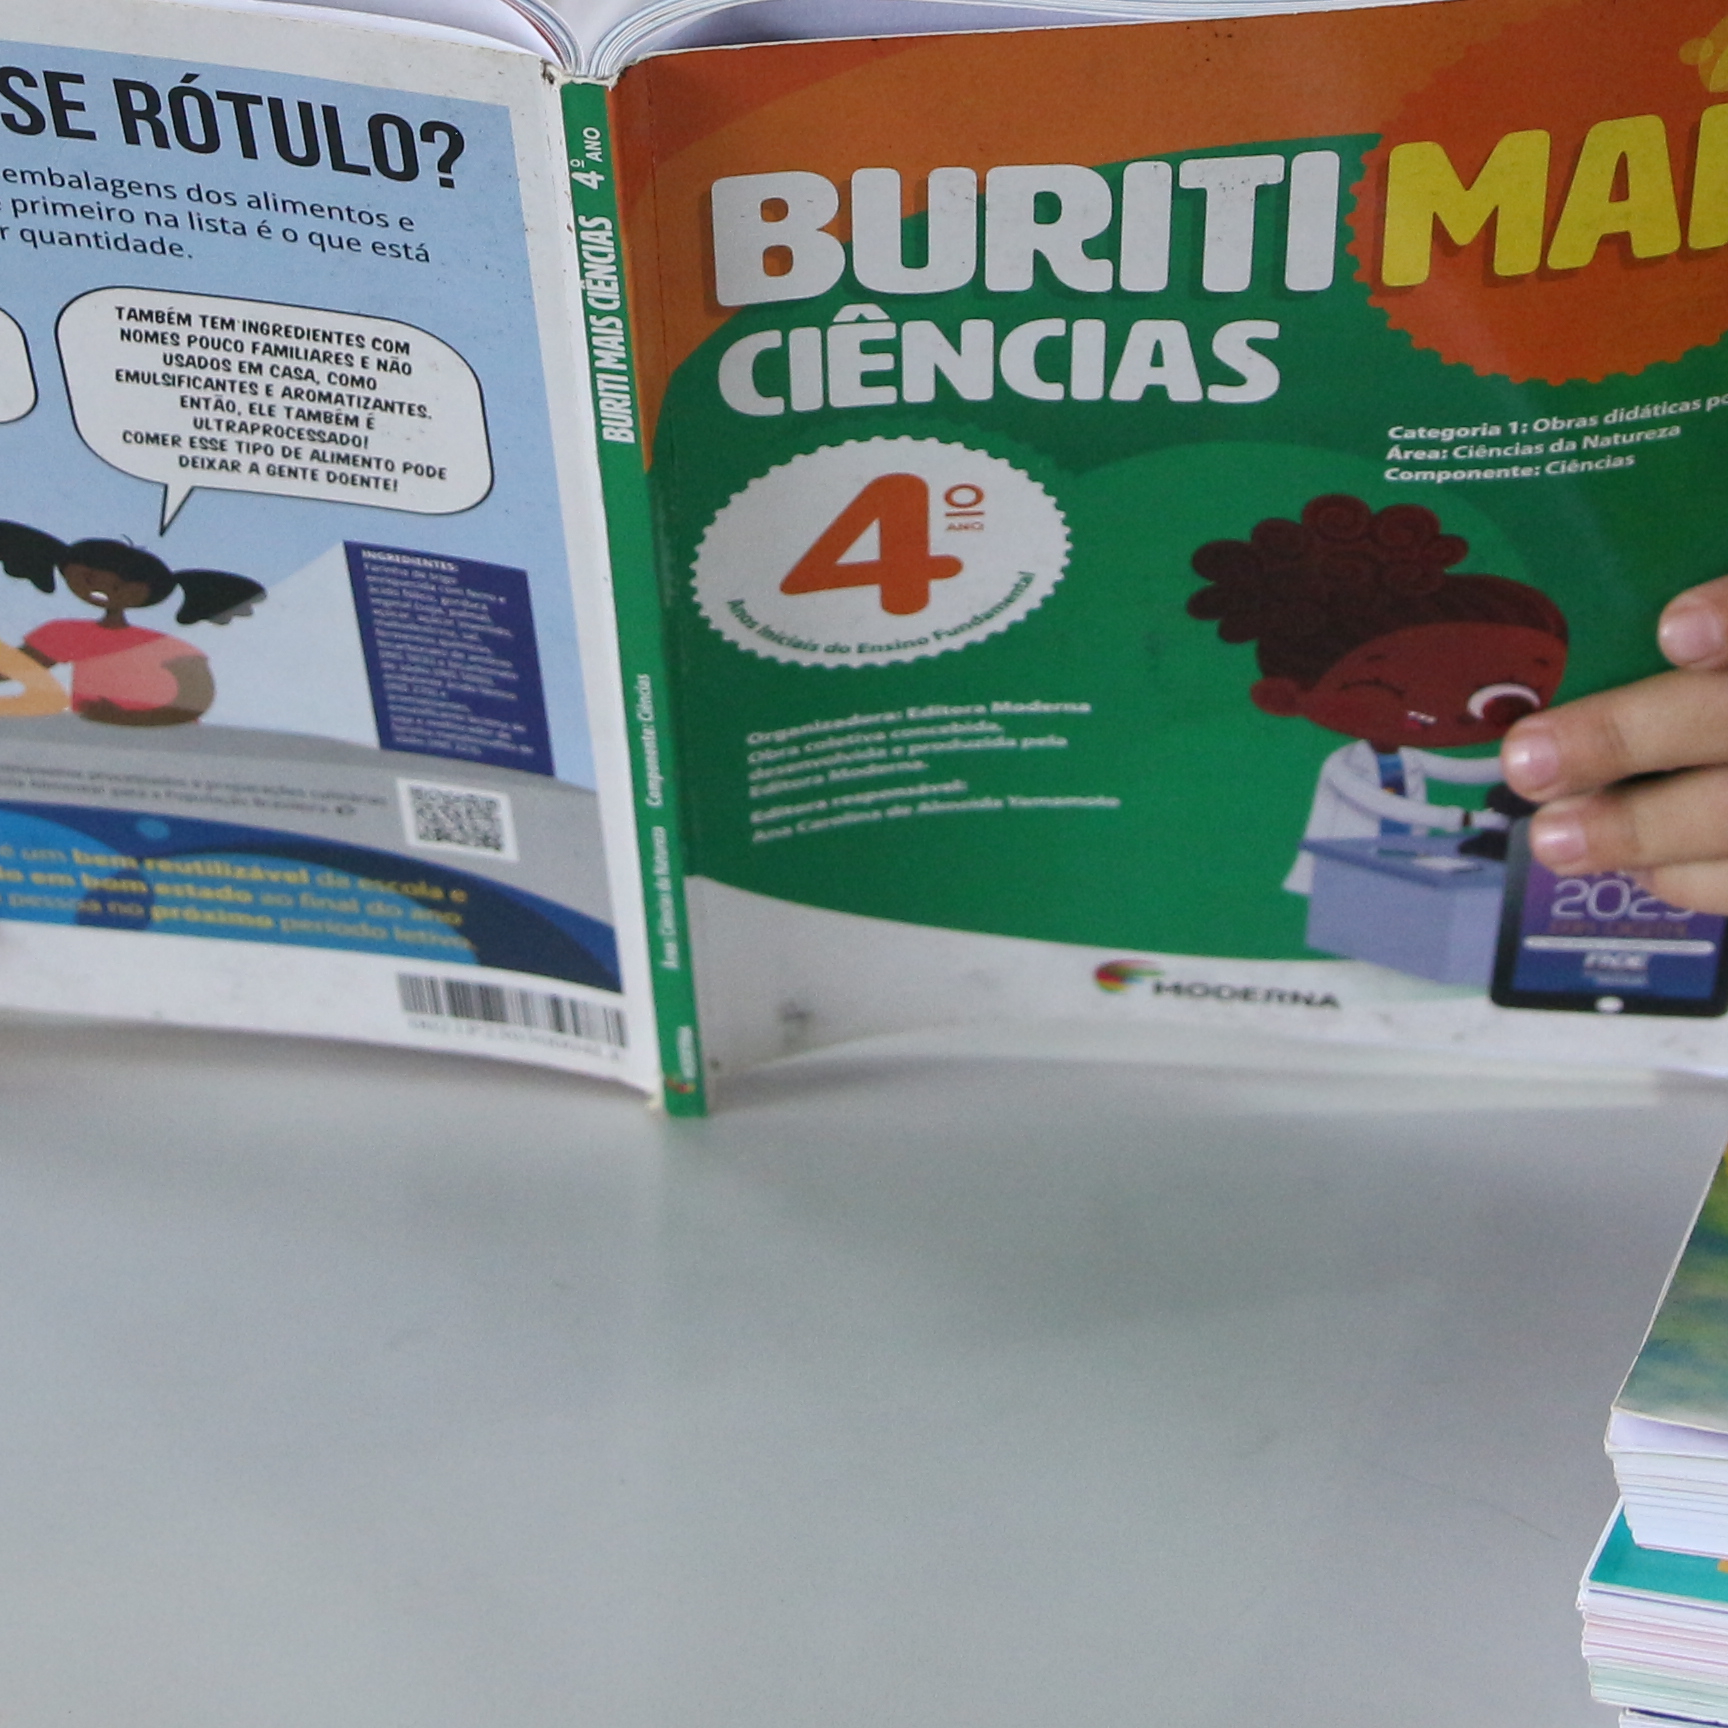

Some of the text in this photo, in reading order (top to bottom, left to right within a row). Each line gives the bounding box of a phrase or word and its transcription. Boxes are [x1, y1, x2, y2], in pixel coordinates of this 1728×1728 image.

[112, 73, 466, 190] RÓTULO?
[582, 126, 605, 164] ANO
[1, 165, 178, 201] embalagens
[185, 182, 238, 207] dos
[246, 190, 390, 229] alimentos
[398, 216, 415, 233] e
[10, 195, 136, 224] primeiro
[143, 210, 180, 230] na
[187, 210, 248, 237] lista
[256, 219, 273, 240] é
[281, 227, 299, 244] o
[307, 231, 362, 254] que
[370, 240, 431, 264] está
[19, 227, 193, 259] quantidade.
[711, 150, 1341, 308] BURITI
[577, 215, 622, 312] CIÊNCIAS
[114, 305, 411, 357] TAMBÉM TEM INGREDIENTES COM
[119, 327, 413, 377] NOMES POUCO FAMILIARES E NÃO
[589, 316, 628, 371] MAIS
[162, 352, 378, 391] USADOS EM CASA, COMO
[717, 304, 1280, 418] CIÊNCIAS
[114, 368, 432, 420] EMULSIFICANTES E AROMATIZANTES.
[179, 394, 375, 431] ENTÃO, ELE TAMBÉM É
[597, 373, 635, 444] BURITI
[192, 416, 369, 450] ULTRAPROCESSADO!
[1385, 423, 1682, 461] Área: Ciências da Natureza
[1388, 423, 1501, 442] Categoria
[1508, 420, 1528, 435] 1:
[1533, 413, 1598, 433] Obras
[1603, 399, 1702, 426] didáticas
[122, 429, 447, 481] COMER ESSE TIPO DE ALIMENTO PODE
[178, 454, 398, 493] DEIXAR A GENTE DOENTE!
[1384, 452, 1636, 484] Componente: Ciências
[824, 642, 852, 655] do
[856, 635, 929, 655] Ensino
[932, 571, 1037, 642] Fundamental
[1551, 878, 1696, 920] 202
[1152, 978, 1341, 1011] MODERNA
